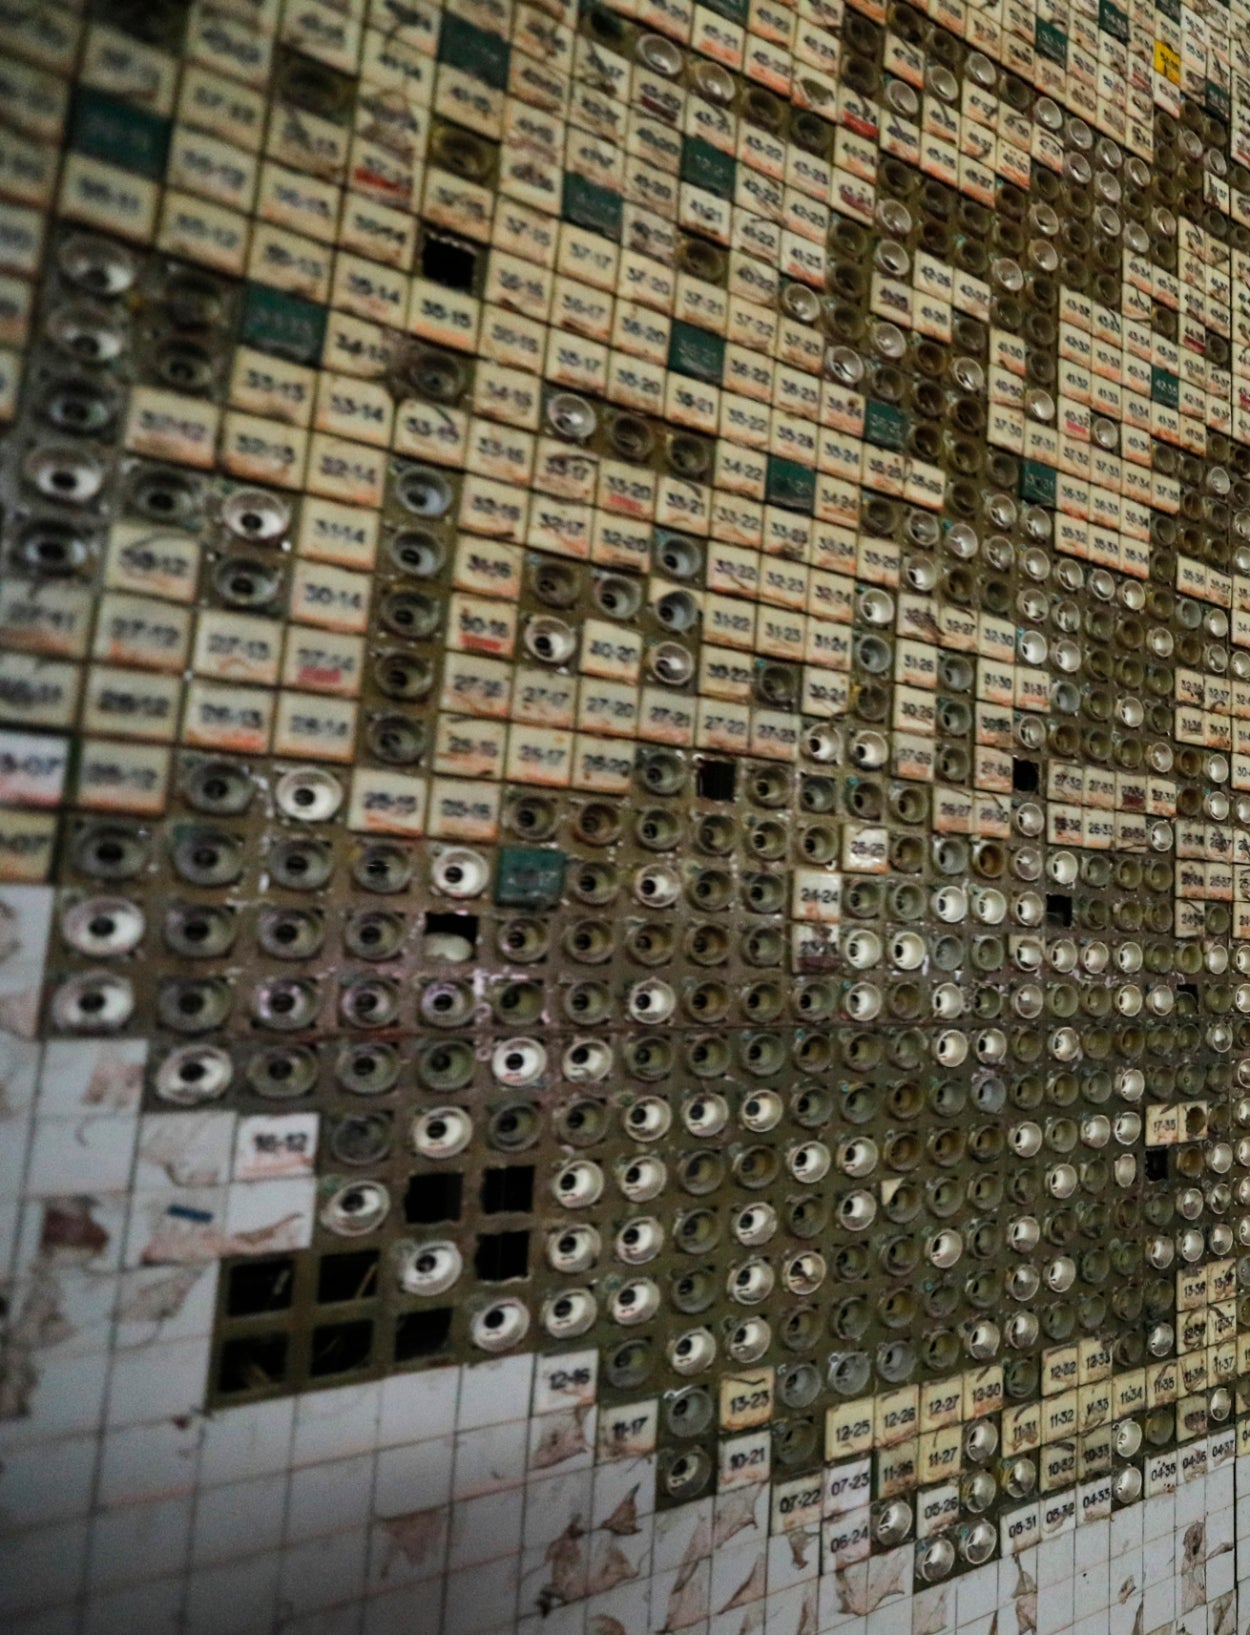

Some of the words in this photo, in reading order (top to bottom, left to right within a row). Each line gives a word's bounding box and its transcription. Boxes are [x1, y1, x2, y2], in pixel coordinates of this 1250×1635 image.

[929, 1394, 960, 1413] 12-27
[884, 1406, 916, 1428] 12-26
[1050, 1410, 1074, 1428] 11-32
[836, 1419, 871, 1442] 12-25
[929, 1447, 958, 1467] 11-27
[1212, 1440, 1233, 1457] 04-37
[831, 1473, 870, 1496] 07-23
[1082, 1489, 1111, 1507] 04-33
